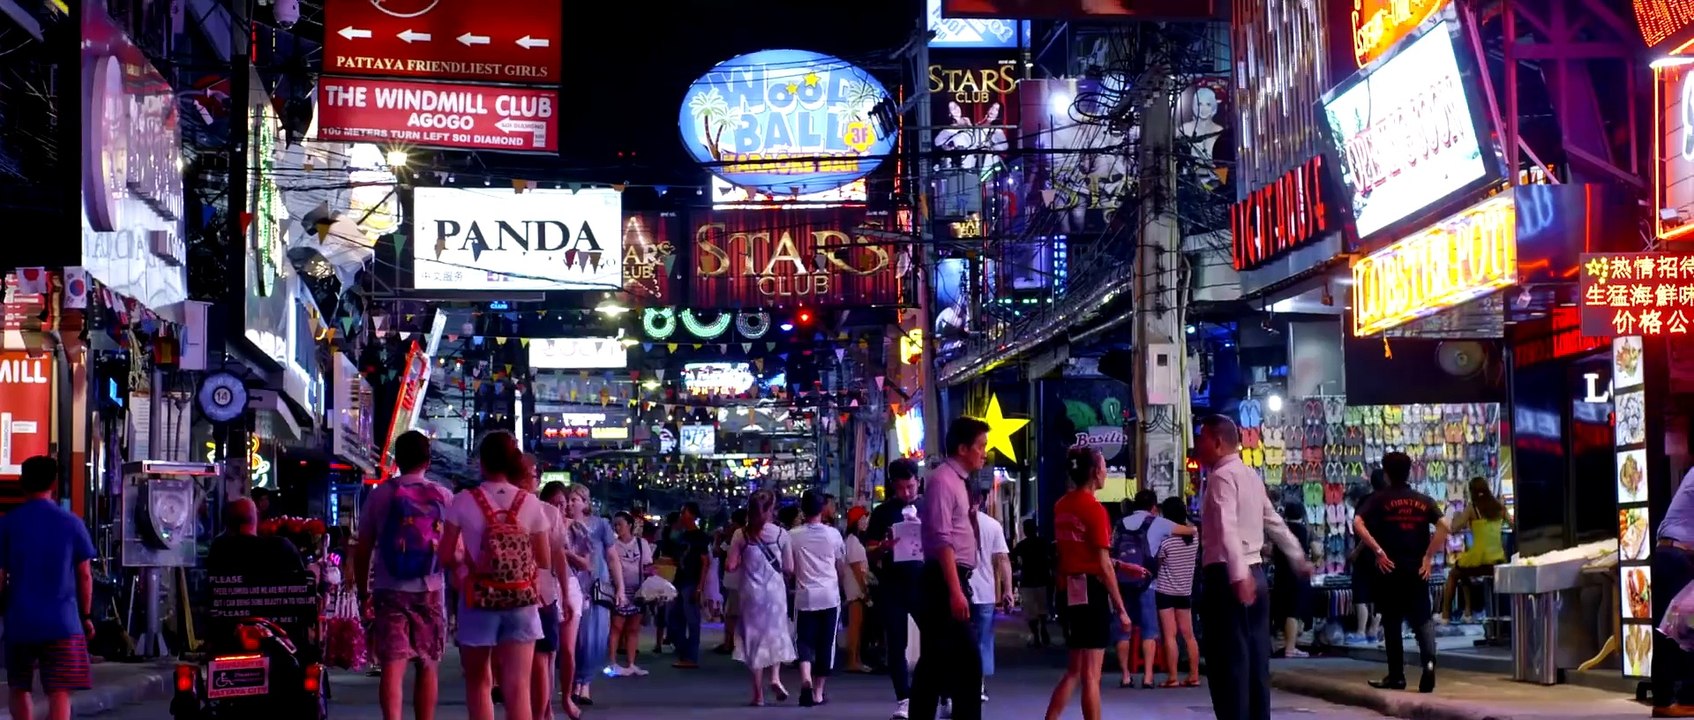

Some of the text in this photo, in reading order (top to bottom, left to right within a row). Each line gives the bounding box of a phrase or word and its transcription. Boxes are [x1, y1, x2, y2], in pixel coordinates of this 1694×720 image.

[337, 56, 548, 77] PATTAYA FRIENDLIEST GIRLS
[928, 65, 1017, 94] STARS
[707, 63, 868, 113] WOOD
[955, 92, 989, 103] CLUB
[325, 86, 552, 117] THE WINDMILL CLUB
[407, 112, 474, 130] AGOGO
[735, 111, 851, 152] BALL
[322, 127, 342, 136] 100
[343, 128, 388, 138] METERS
[390, 130, 420, 140] TURN
[423, 131, 450, 142] LEFT
[452, 133, 471, 143] SOI
[474, 134, 524, 146] DIAMOND
[851, 127, 868, 143] 3F
[434, 219, 604, 252] PANDA
[697, 221, 890, 277] STARS
[757, 275, 830, 296] CLUB
[1612, 308, 1694, 334] 价格公
[1583, 373, 1614, 403] L
[209, 575, 243, 584] PLEASE
